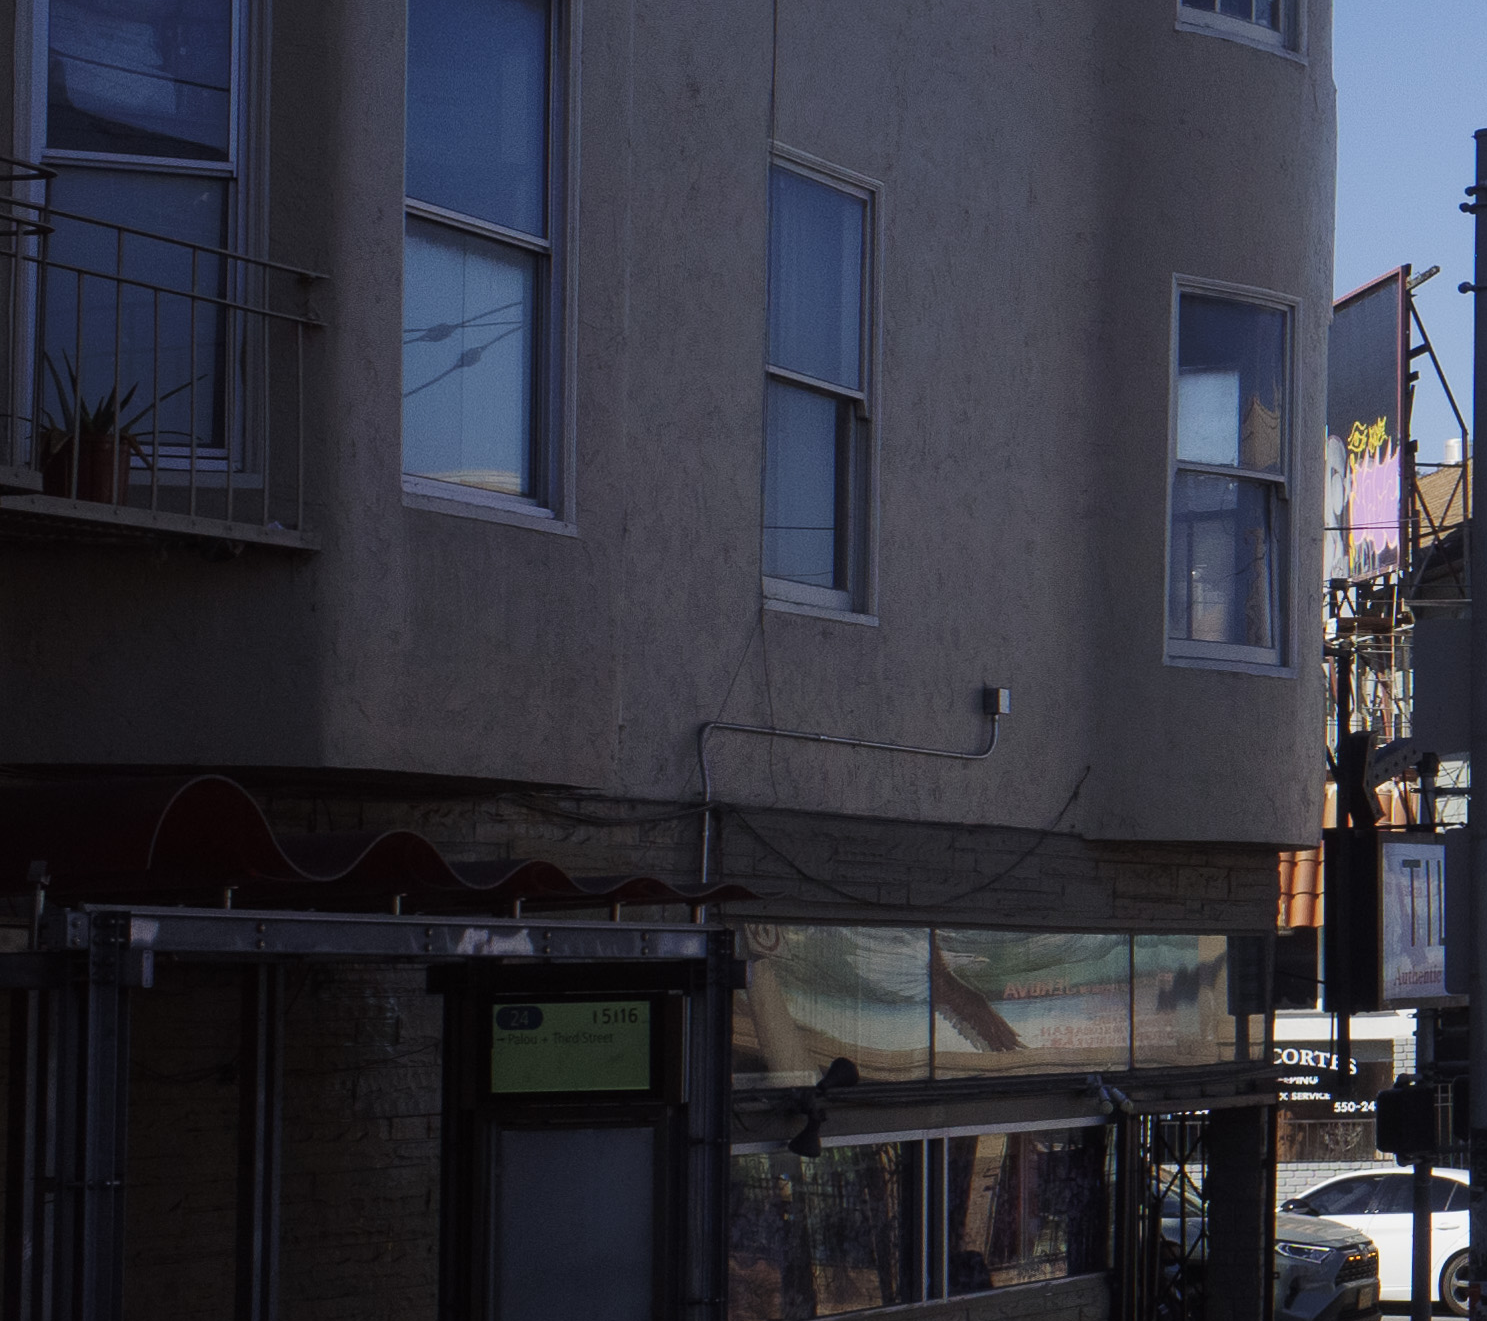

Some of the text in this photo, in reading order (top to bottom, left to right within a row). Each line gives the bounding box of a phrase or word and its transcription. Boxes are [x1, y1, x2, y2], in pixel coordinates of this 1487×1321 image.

[511, 1011, 529, 1026] 24
[552, 1032, 579, 1044] Third
[583, 1031, 613, 1044] Street
[1291, 1092, 1331, 1101] SERVICE
